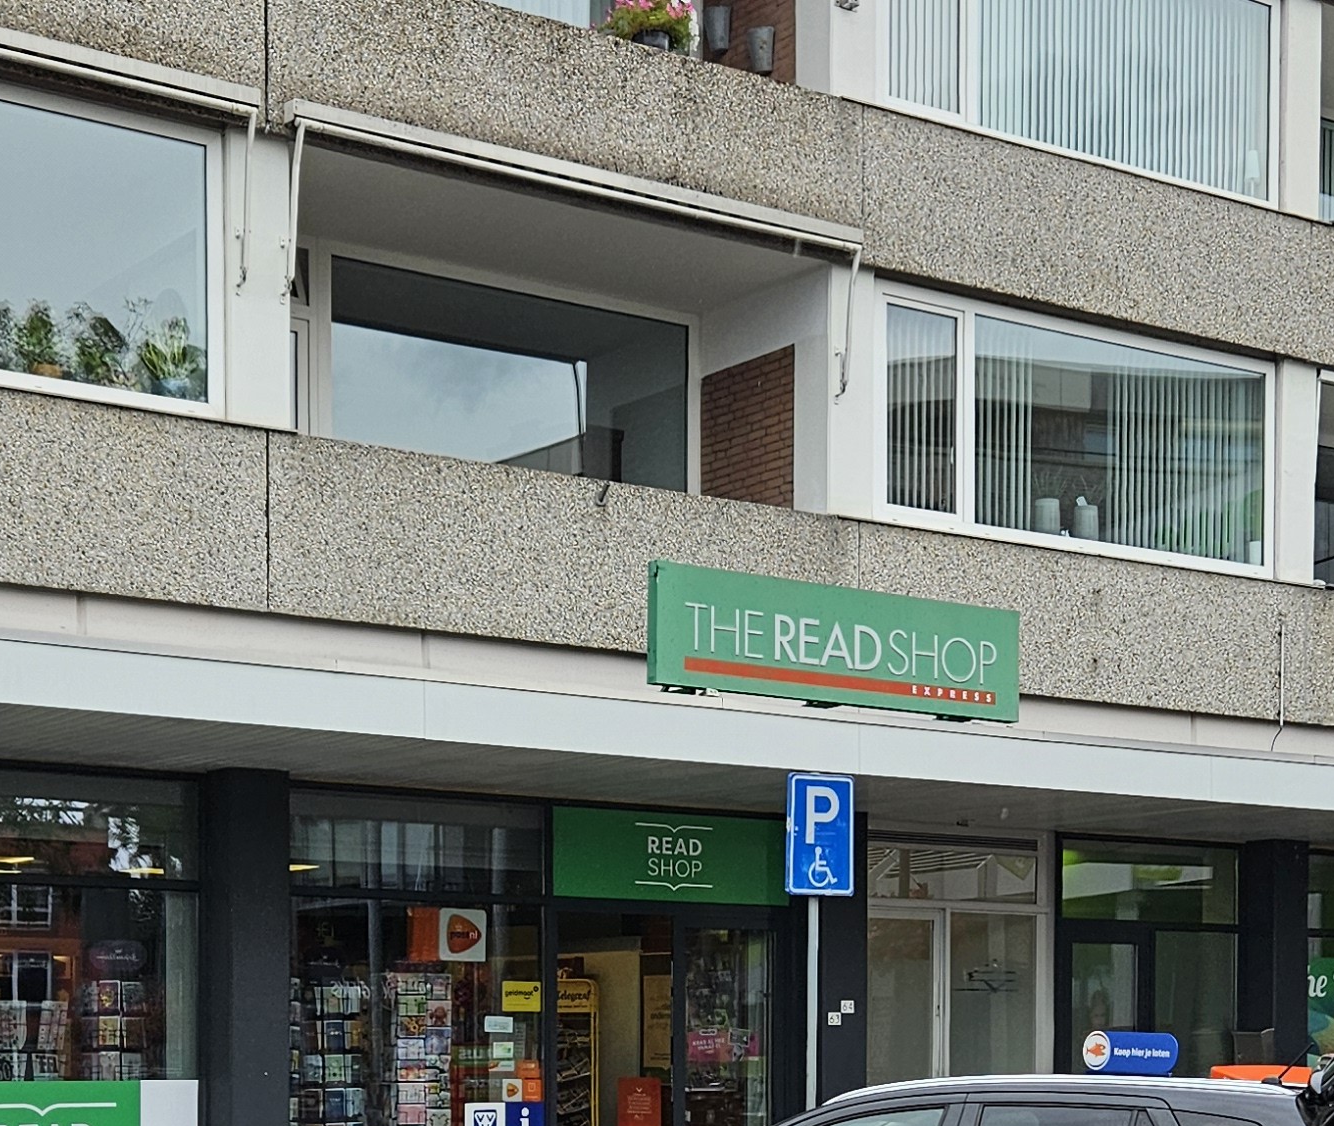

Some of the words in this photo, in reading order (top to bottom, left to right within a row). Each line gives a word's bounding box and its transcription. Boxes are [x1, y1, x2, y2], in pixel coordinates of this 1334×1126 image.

[684, 602, 764, 659] THE
[774, 613, 882, 672] READ
[887, 629, 998, 685] SHOP
[910, 684, 993, 703] EXPRESS
[805, 785, 840, 845] P
[647, 836, 703, 856] READ
[647, 857, 703, 878] SHOP
[1307, 965, 1327, 998] he
[1113, 1047, 1131, 1058] Koop
[1131, 1048, 1145, 1057] hier
[1144, 1048, 1152, 1059] je
[1152, 1048, 1170, 1058] loten
